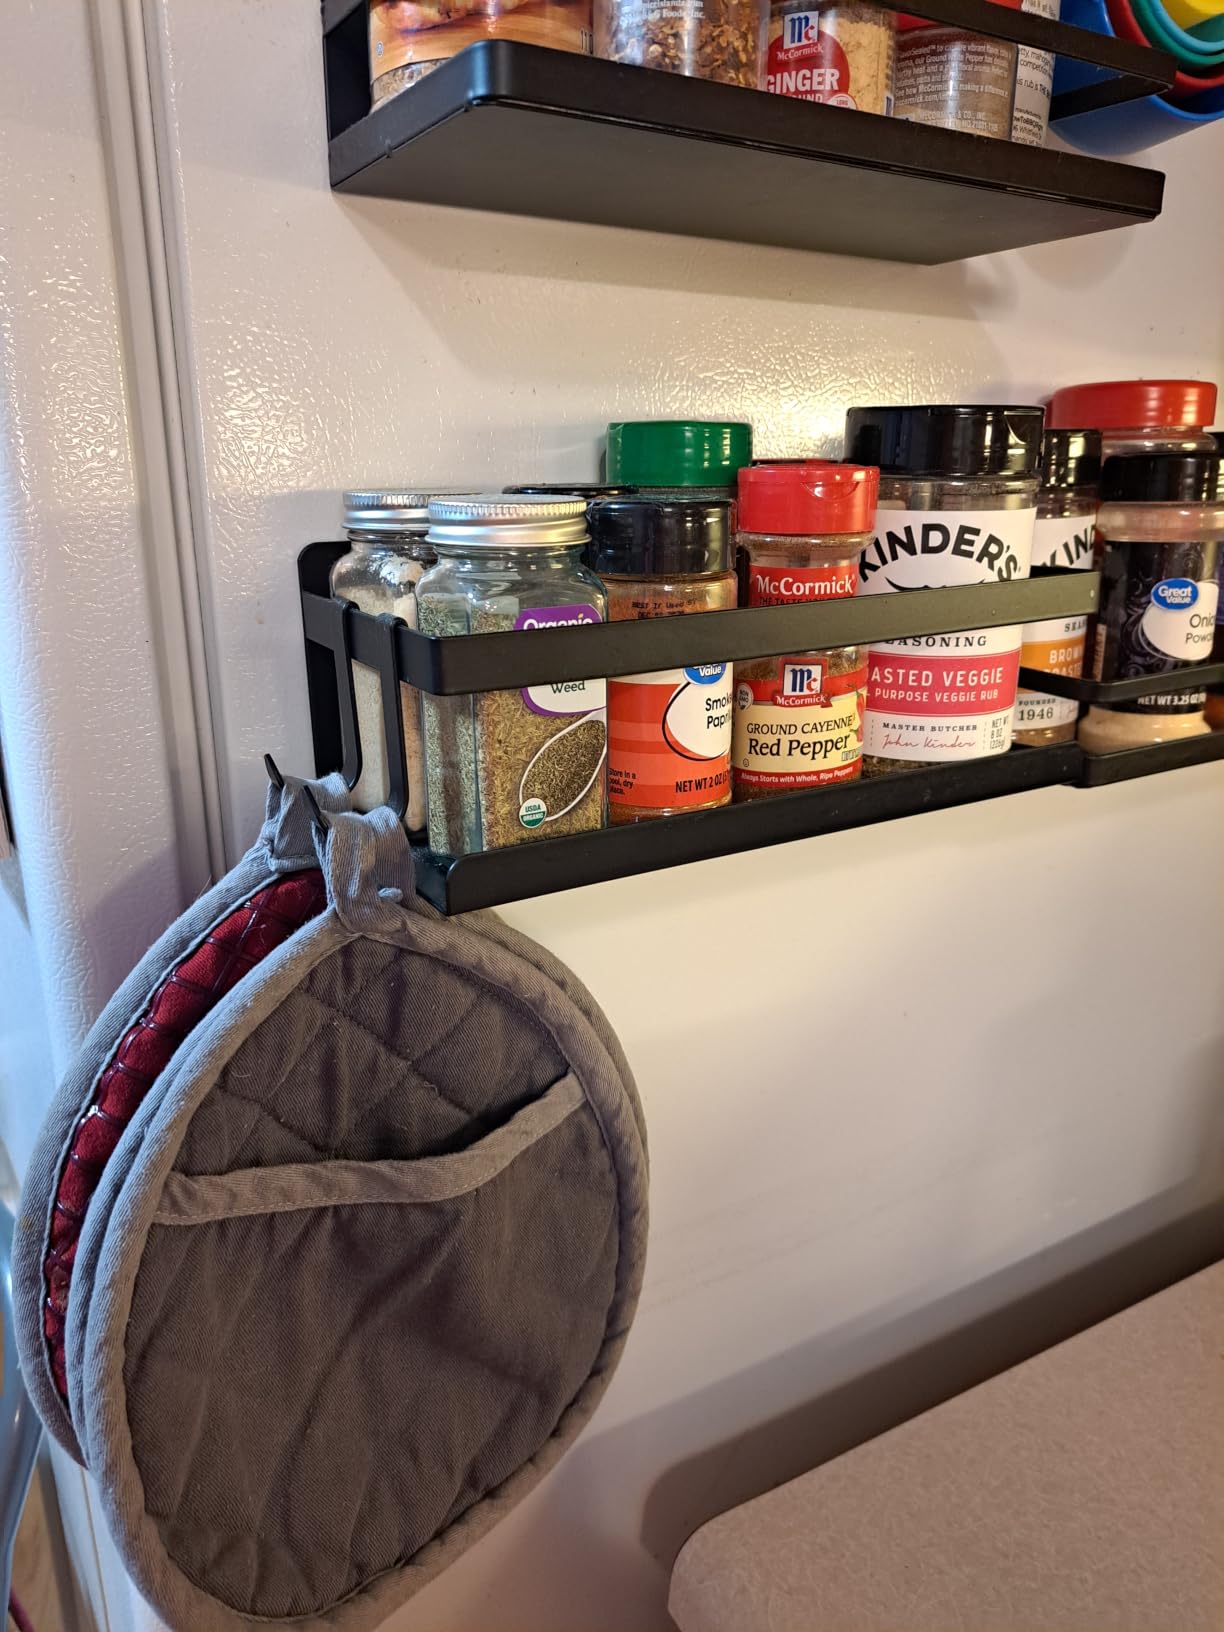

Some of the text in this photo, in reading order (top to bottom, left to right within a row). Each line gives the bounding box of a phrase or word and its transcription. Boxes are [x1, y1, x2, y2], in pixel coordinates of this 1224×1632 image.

[777, 44, 825, 60] McCormick
[926, 55, 947, 63] Ground
[767, 68, 840, 94] GINGER
[859, 523, 1018, 582] KINDER'S
[756, 575, 853, 595] McCormick
[1158, 585, 1192, 598] Great
[1166, 595, 1191, 604] Value
[884, 635, 987, 648] ASONING
[699, 664, 722, 677] Value
[871, 665, 1004, 687] ASTED VEGGIE
[551, 681, 586, 694] Weed
[776, 695, 827, 706] McCormick
[874, 687, 999, 703] PURPOSE VEGGIE RUB
[1157, 695, 1172, 705] WT
[1018, 707, 1054, 721] 1946
[746, 714, 853, 735] GROUND CAYENNE
[882, 722, 978, 732] MASTER BUTCHER
[748, 733, 851, 760] Red Pepper
[923, 735, 977, 749] Kinder
[623, 779, 634, 790] dry
[675, 780, 693, 793] NET
[694, 778, 708, 791] WT
[709, 777, 713, 788] 2
[714, 773, 722, 785] OZ
[525, 804, 541, 812] USDA
